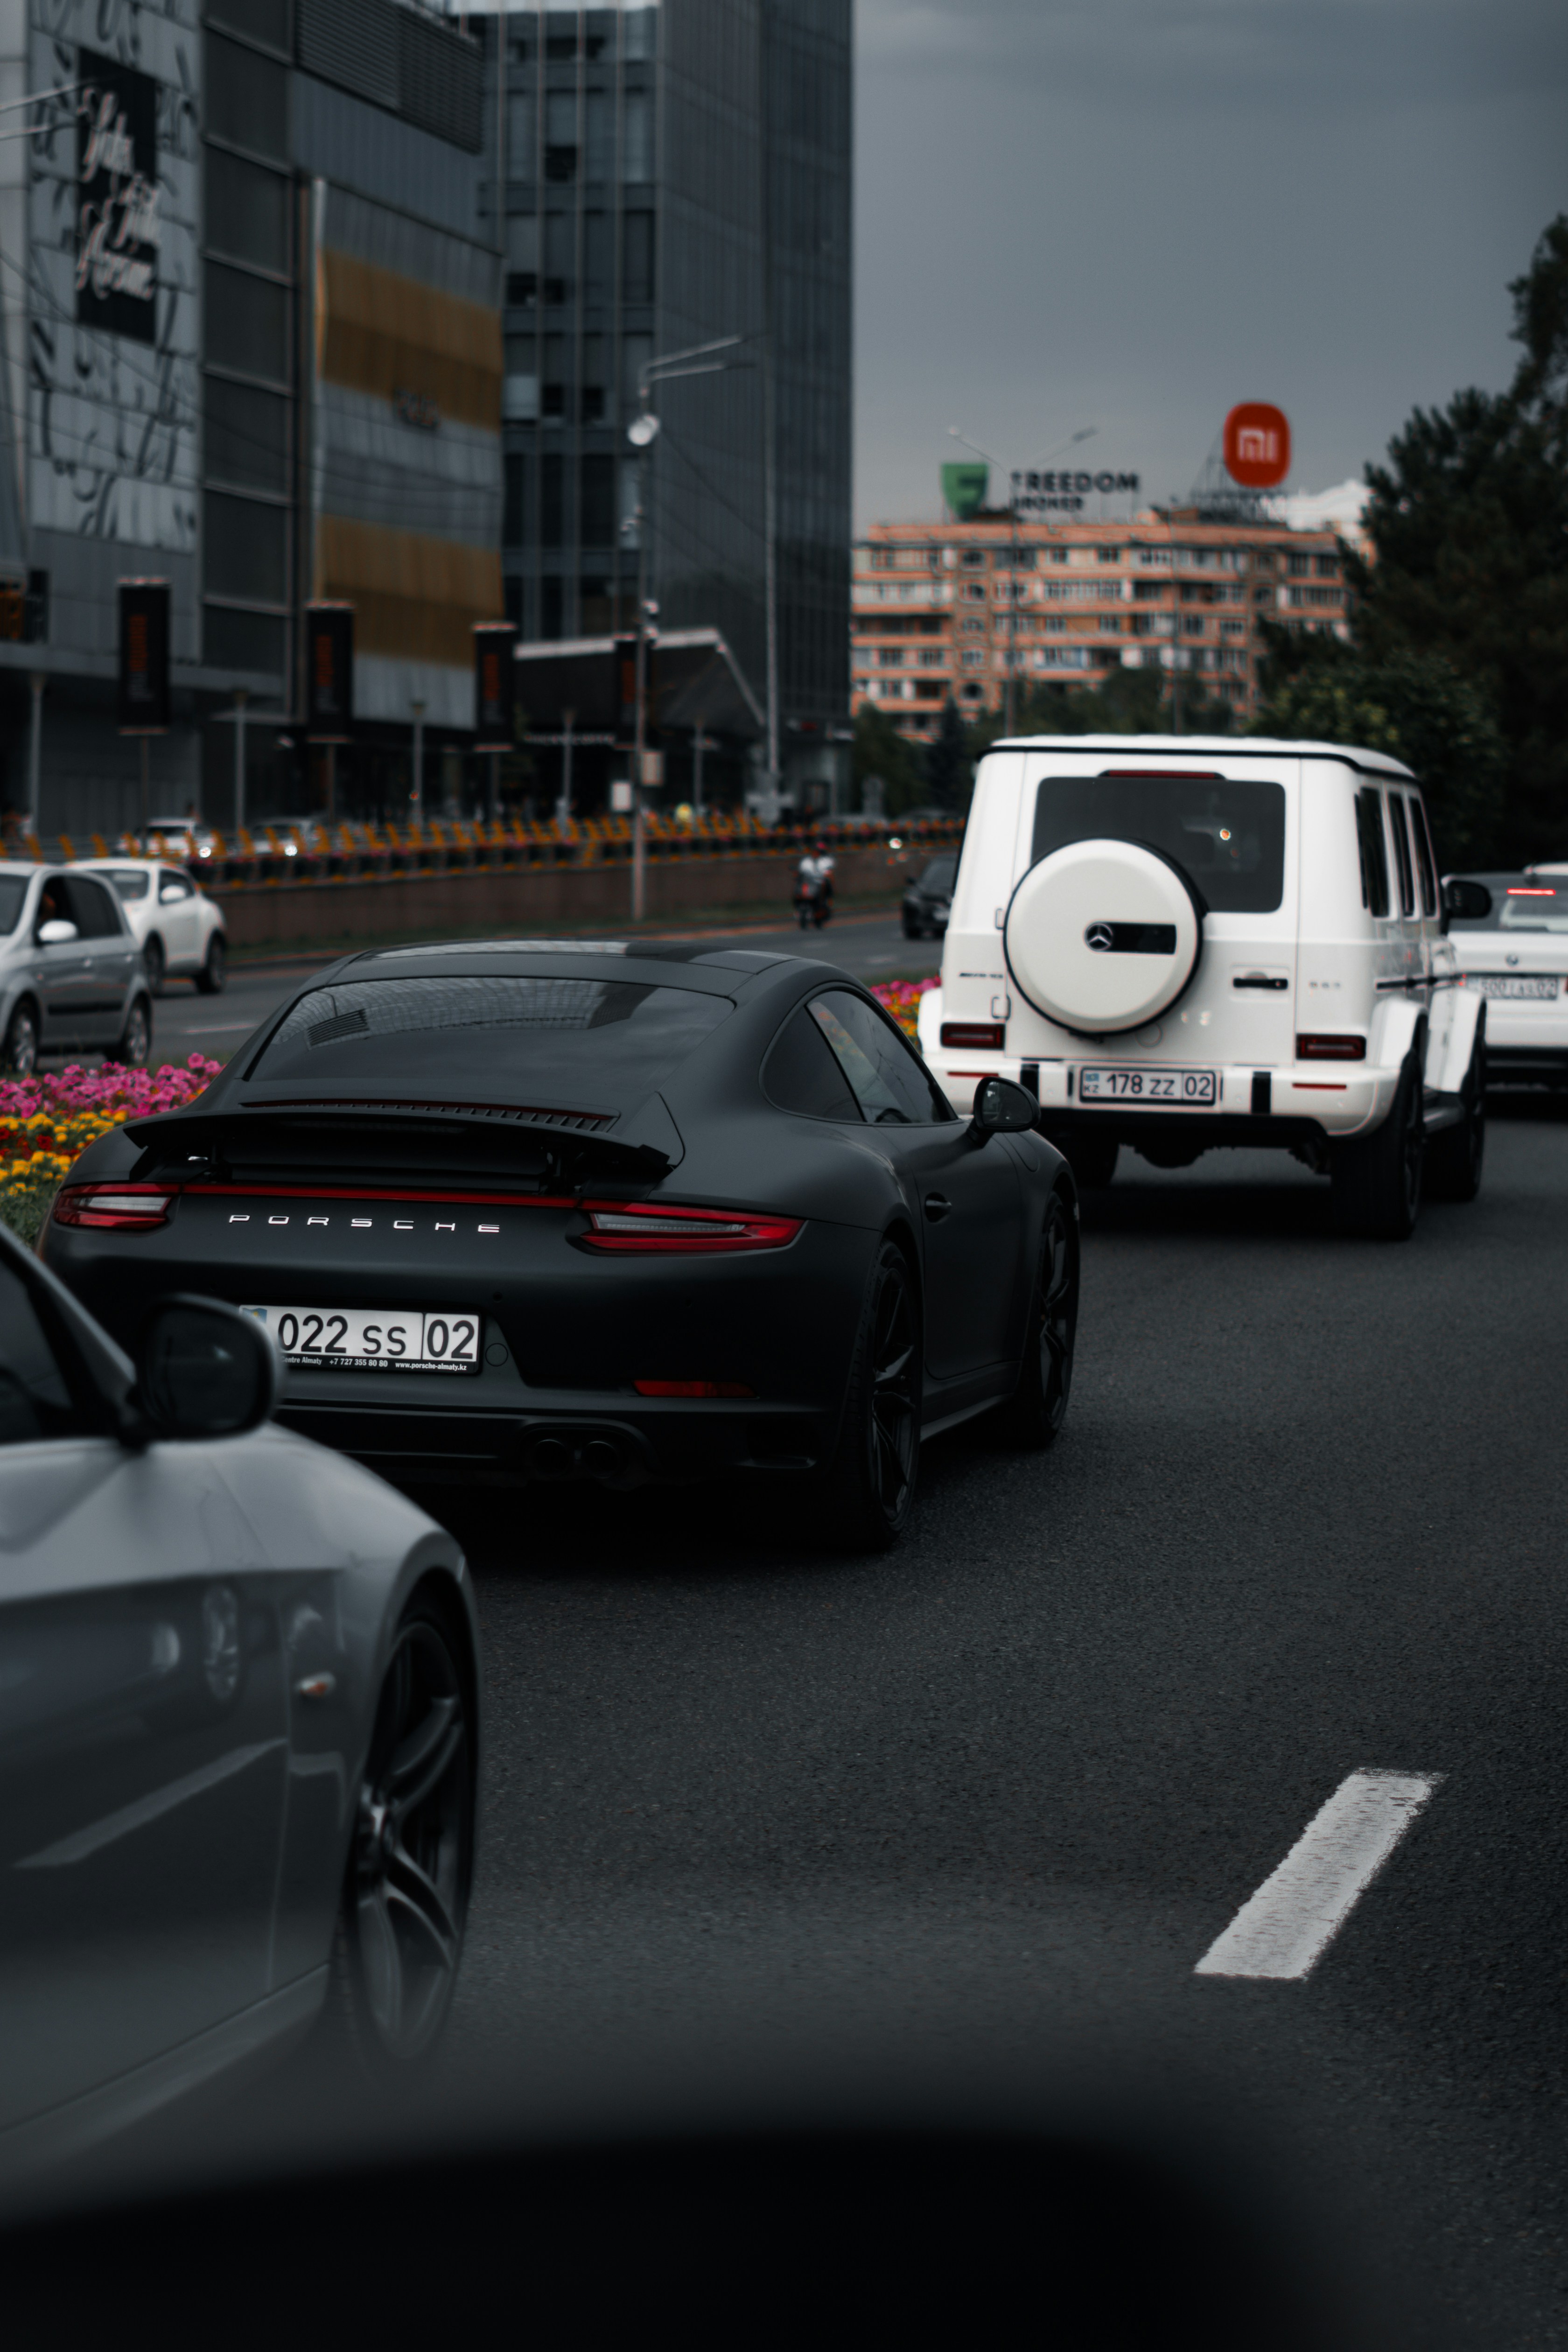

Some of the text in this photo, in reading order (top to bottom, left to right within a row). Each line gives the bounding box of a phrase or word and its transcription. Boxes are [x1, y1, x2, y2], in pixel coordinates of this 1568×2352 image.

[1084, 1085, 1099, 1093] KZ
[1107, 1074, 1211, 1096] 178 ZZ 02
[229, 1215, 500, 1232] PORSCHE
[278, 1313, 475, 1358] 022 SS 02
[301, 1357, 322, 1365] Almaty
[395, 1362, 467, 1371] www.porsche-almaty.kz
